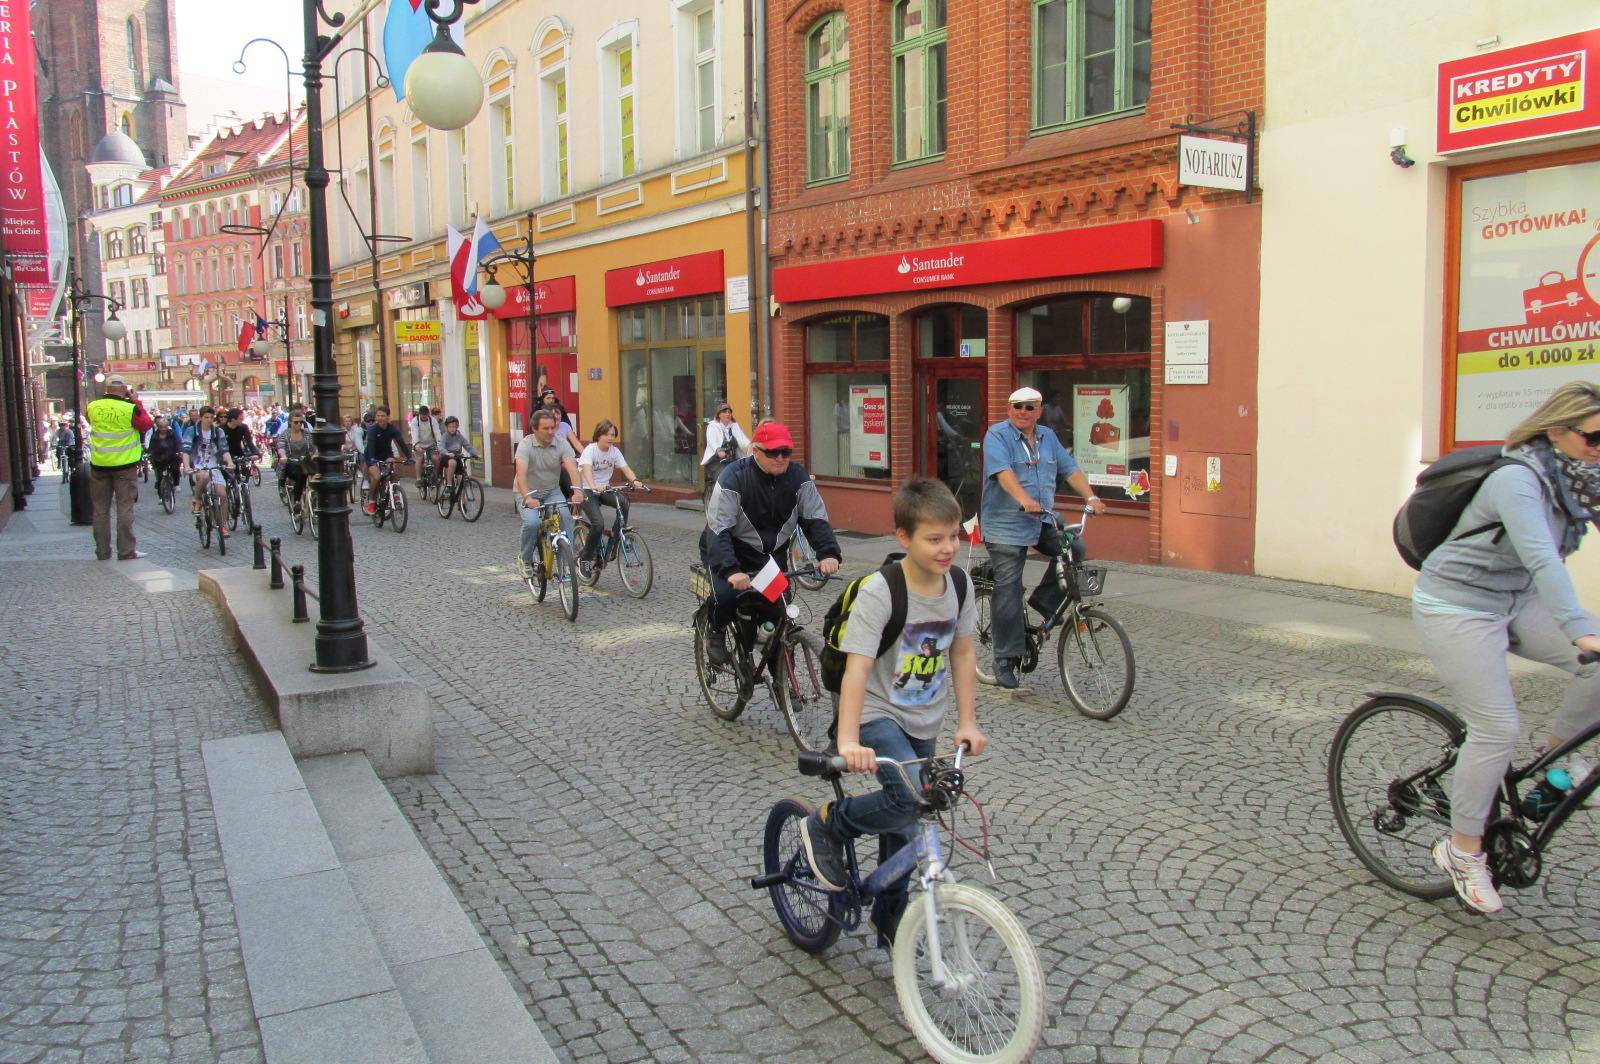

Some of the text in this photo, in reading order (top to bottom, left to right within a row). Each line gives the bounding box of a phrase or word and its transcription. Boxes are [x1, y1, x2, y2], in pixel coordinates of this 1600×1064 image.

[1457, 61, 1576, 98] KREDYTY
[1456, 86, 1576, 123] Chwilówki
[3, 79, 27, 201] PIASTÓW
[1184, 147, 1243, 179] NOTARIUSZ
[4, 217, 35, 226] Miejsce
[1471, 200, 1527, 223] Szybka
[1481, 207, 1587, 240] GOTÓWKA!
[15, 227, 41, 235] Ciebie
[912, 252, 964, 272] Santander
[645, 265, 681, 285] Santander
[912, 274, 940, 284] CONSUMER
[1498, 343, 1595, 368] do 1.000 zł
